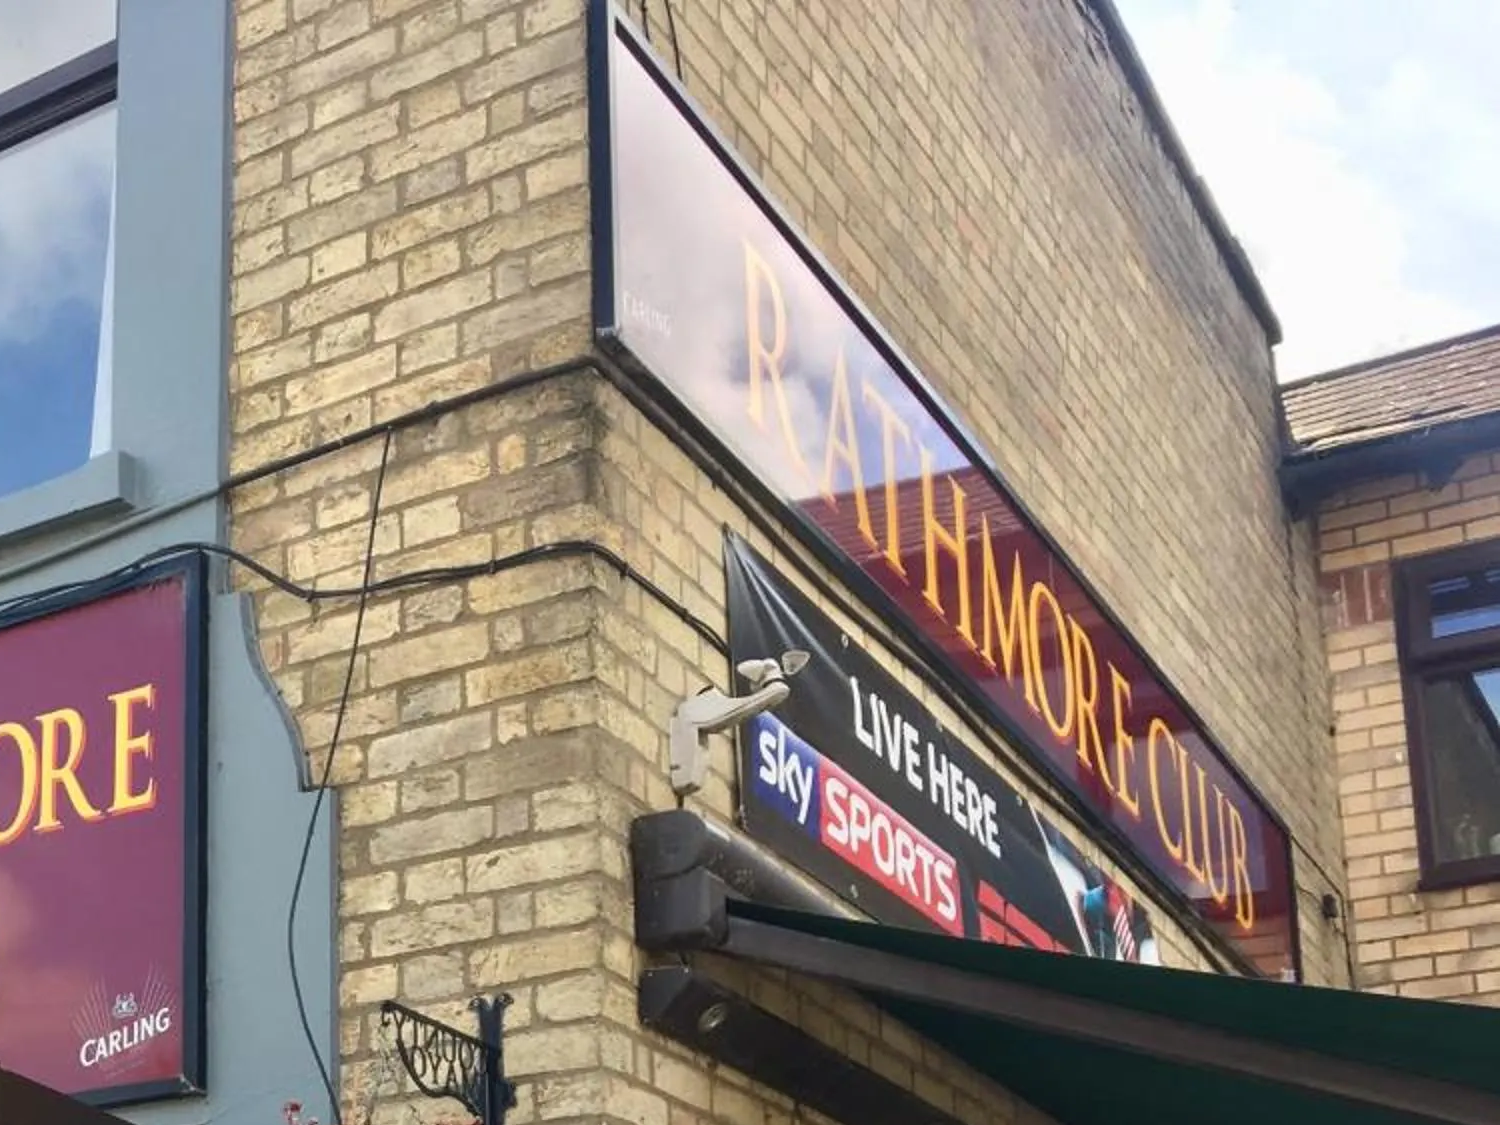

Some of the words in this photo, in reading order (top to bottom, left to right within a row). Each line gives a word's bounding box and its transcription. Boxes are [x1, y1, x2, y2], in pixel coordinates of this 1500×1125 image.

[742, 233, 1139, 821] RATHMORE
[1147, 718, 1254, 929] CLUB
[758, 724, 814, 825] sky
[824, 777, 958, 924] SPORTS
[850, 675, 924, 792] LIVE
[928, 741, 1002, 859] HERE
[80, 1007, 171, 1067] CARLING
